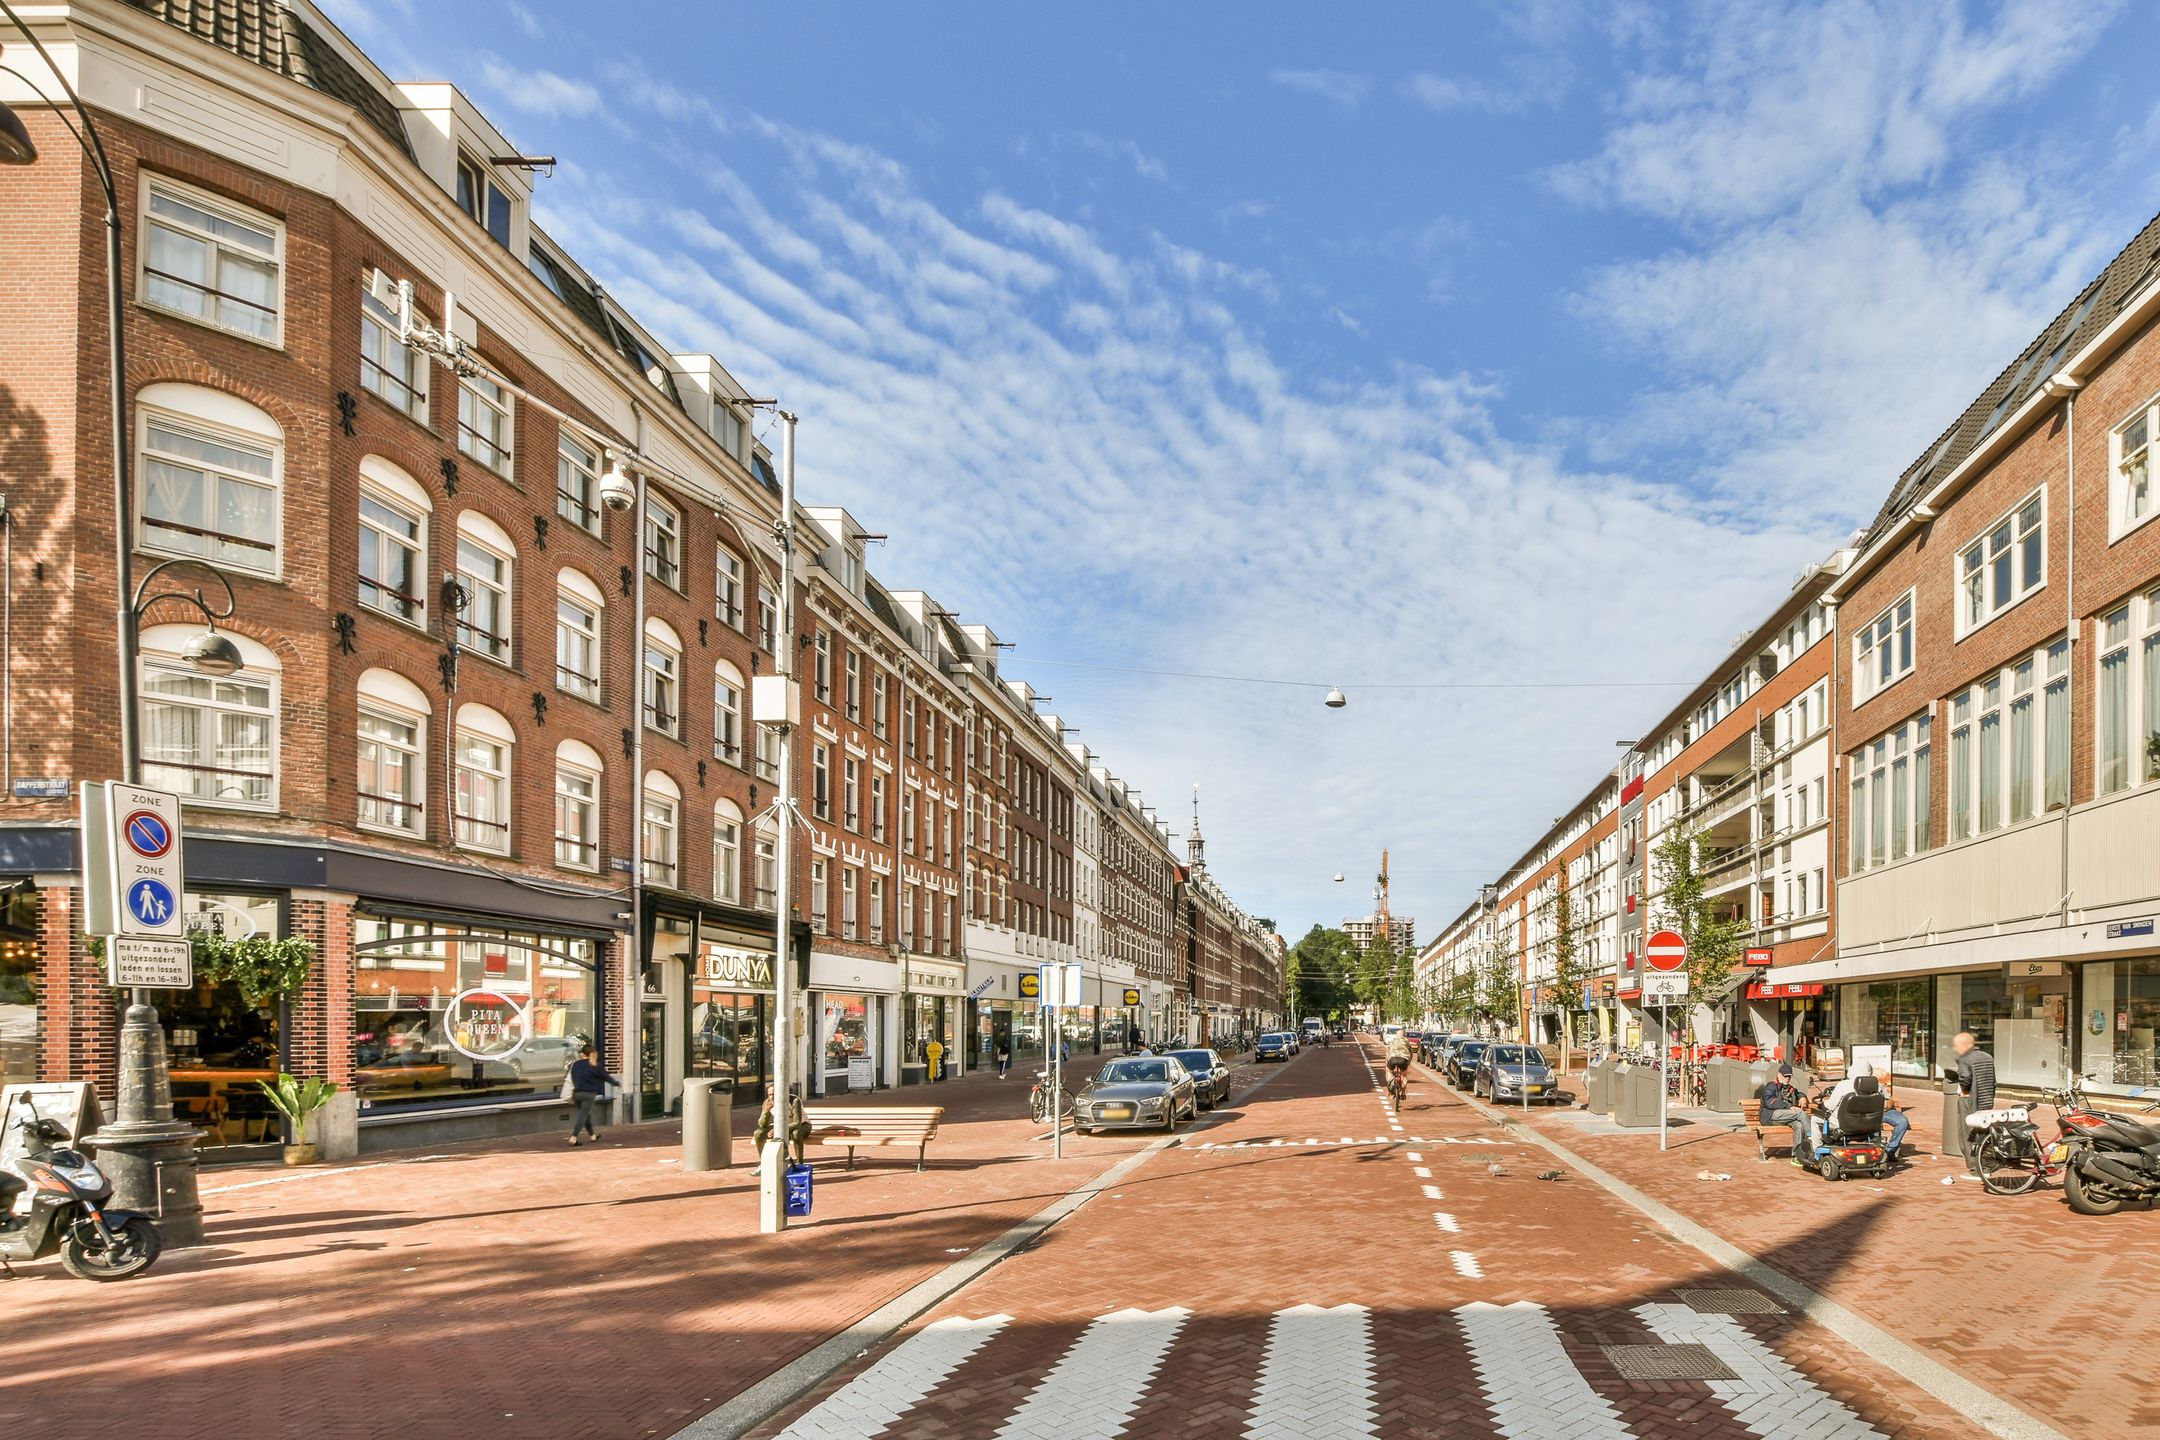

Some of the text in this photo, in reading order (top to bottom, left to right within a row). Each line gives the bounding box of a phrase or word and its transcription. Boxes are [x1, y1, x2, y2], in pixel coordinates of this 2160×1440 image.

[16, 781, 66, 789] DAPPERSTRAAT
[131, 794, 162, 807] ZONE
[136, 864, 165, 876] ZONE
[134, 944, 150, 952] t/m
[164, 945, 186, 954] 6-19h
[121, 954, 176, 963] uitgezonderd
[119, 964, 143, 972] laden
[158, 965, 183, 974] lossen
[710, 955, 771, 982] DUNYA
[2029, 963, 2042, 974] Etos
[122, 974, 143, 983] 6-11h
[158, 975, 183, 983] 16-18h
[648, 984, 655, 993] 66
[471, 1009, 501, 1020] PITA
[466, 1023, 505, 1036] QUEEN
